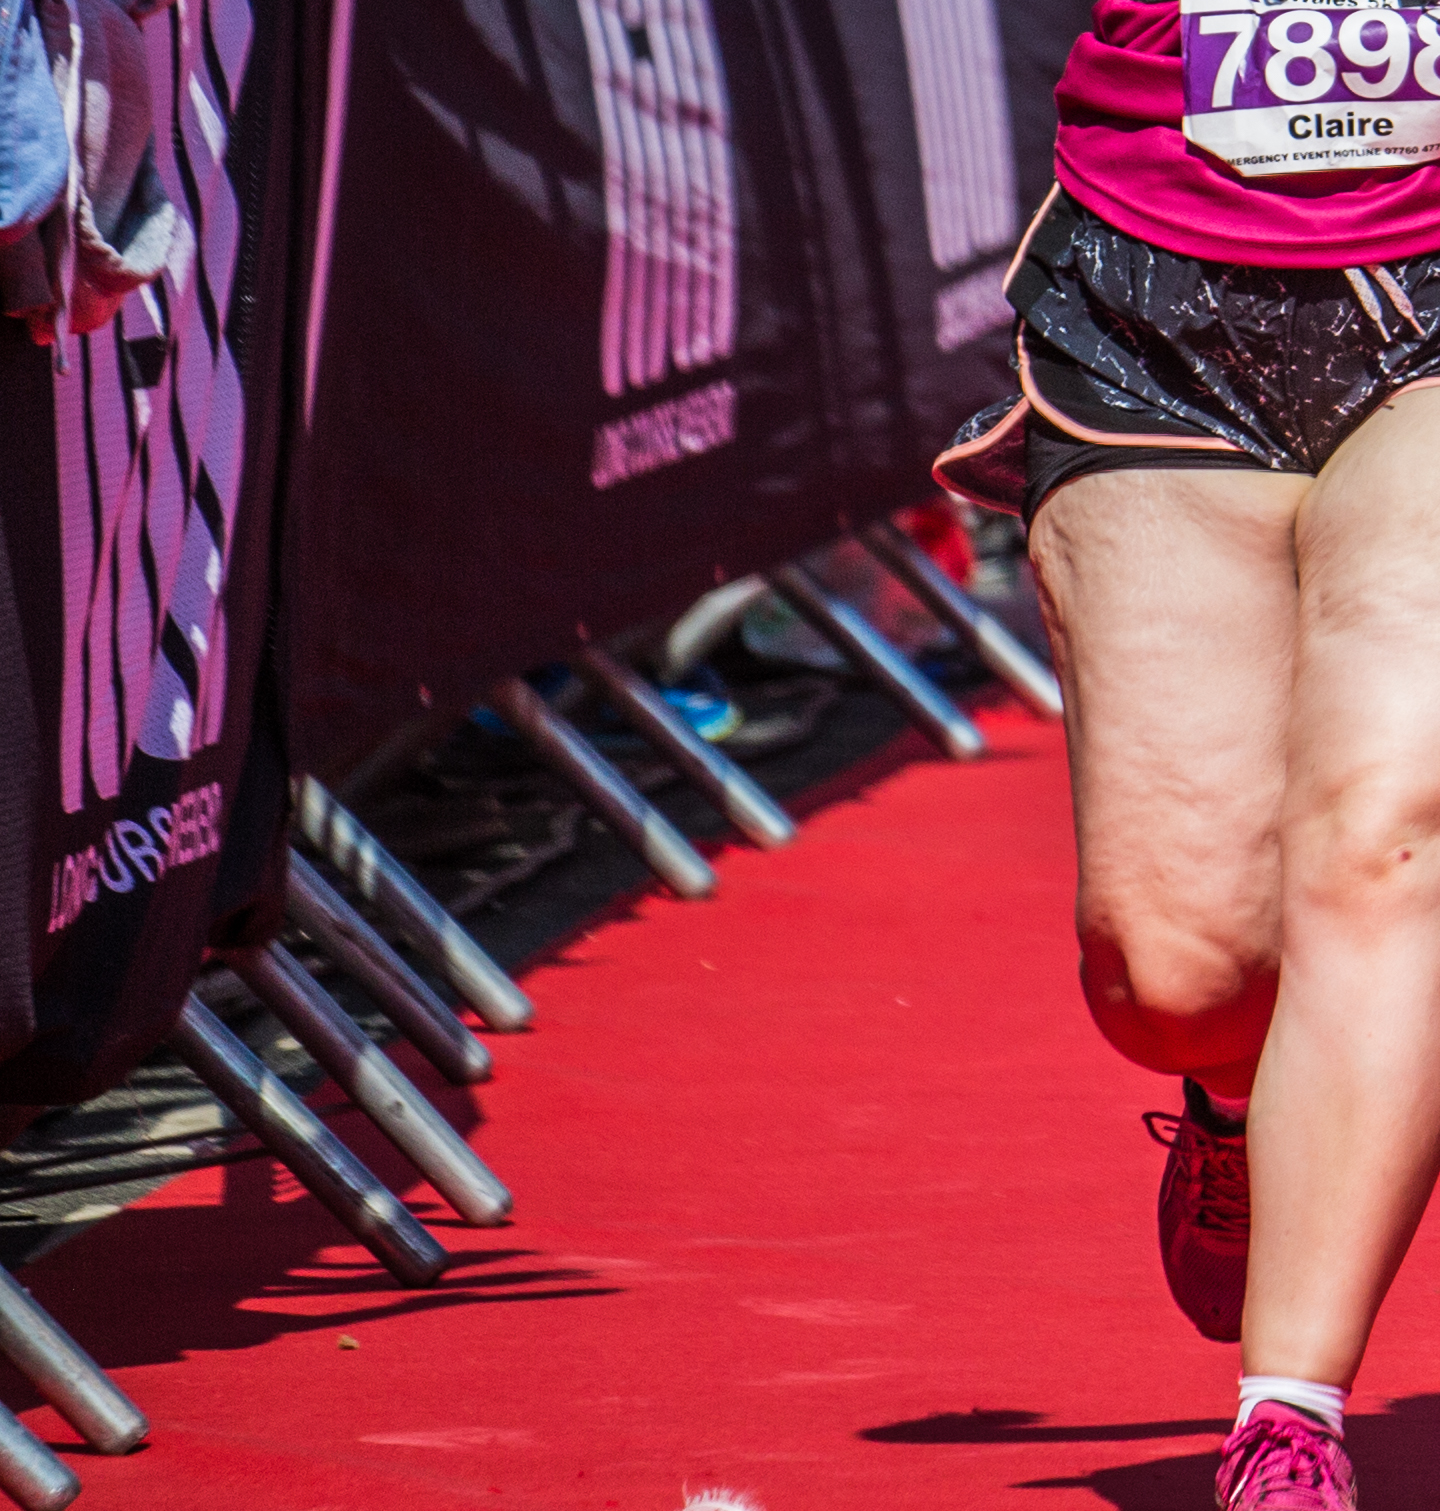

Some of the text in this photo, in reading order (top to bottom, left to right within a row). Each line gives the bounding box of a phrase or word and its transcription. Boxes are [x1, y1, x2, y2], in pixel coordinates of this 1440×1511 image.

[1287, 111, 1394, 140] Claire
[1293, 150, 1331, 161] EVENT
[1333, 146, 1382, 158] HOTLINE
